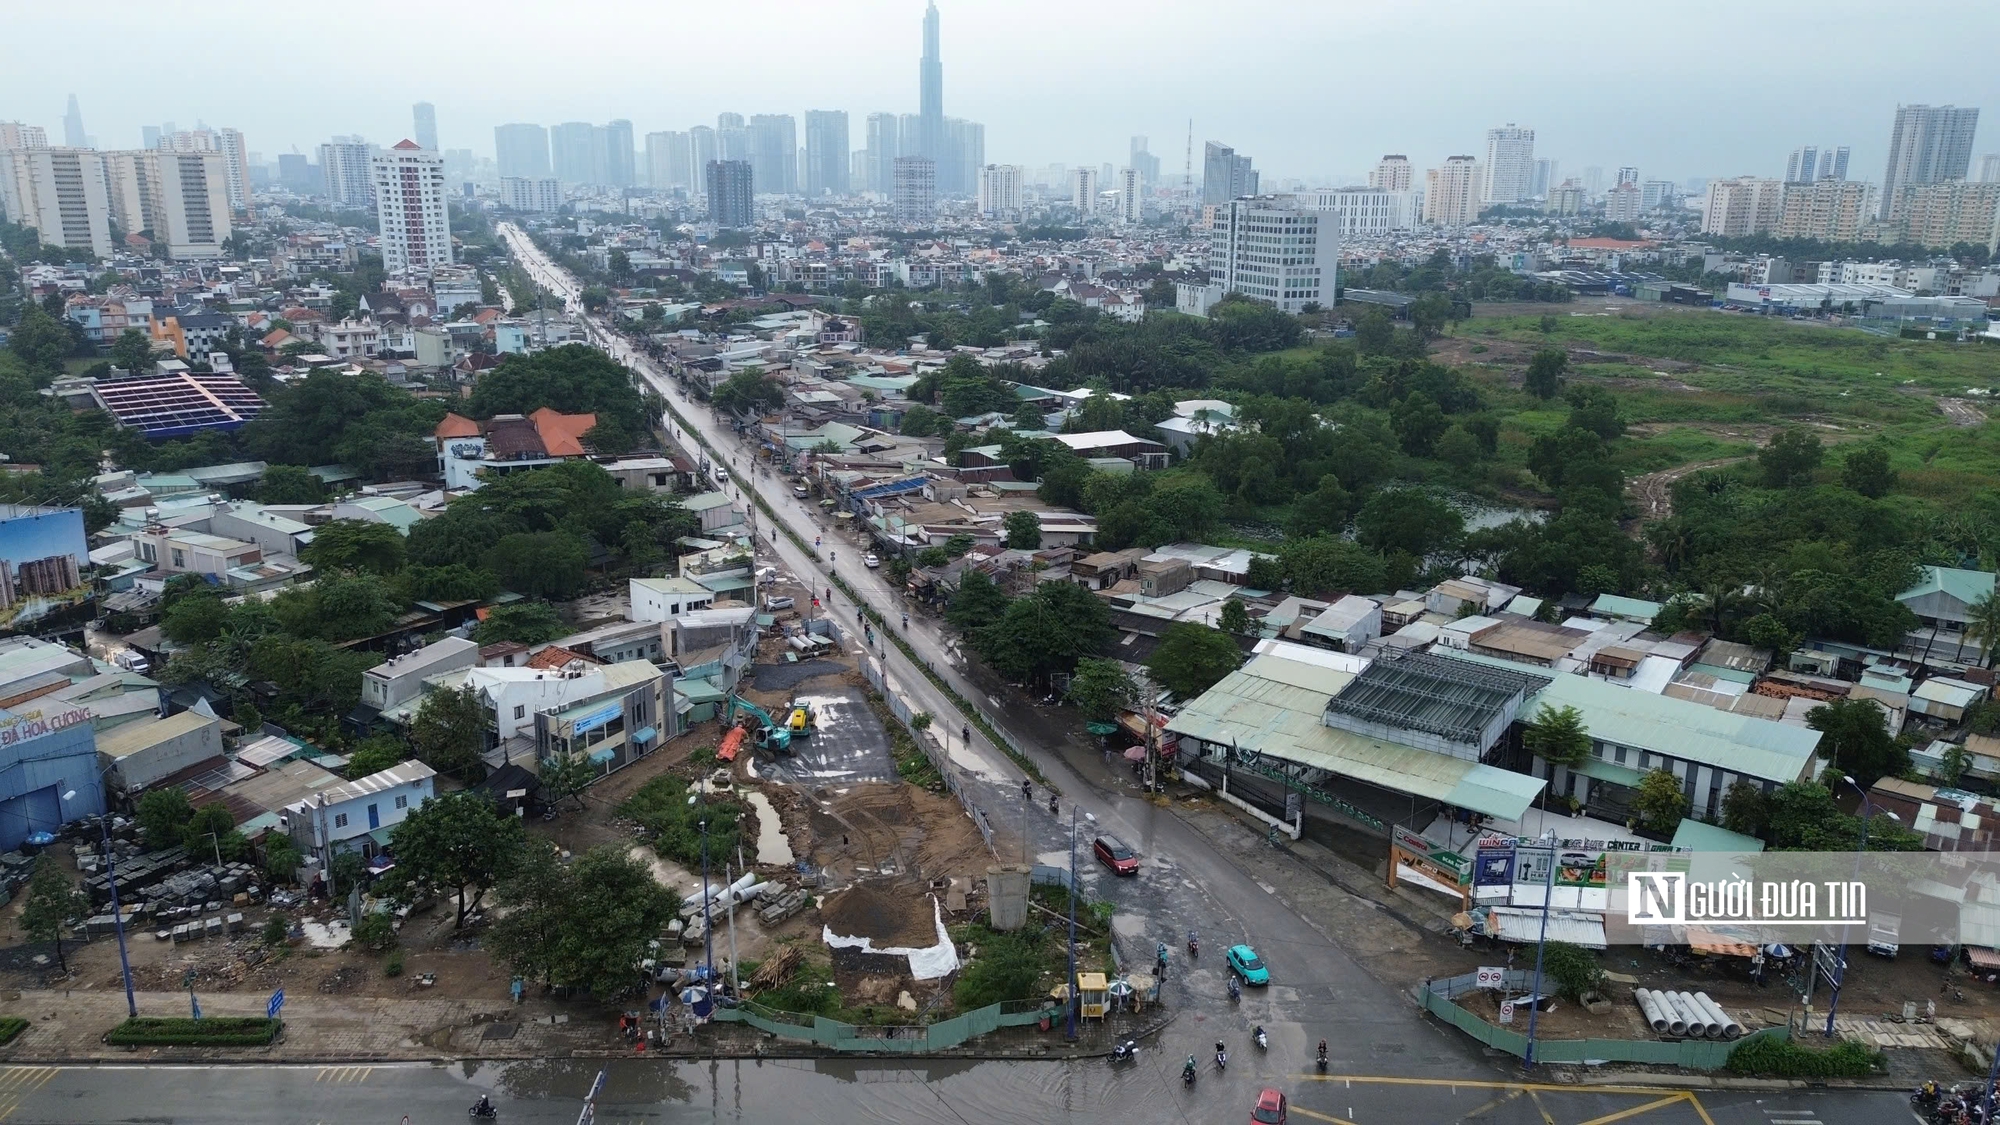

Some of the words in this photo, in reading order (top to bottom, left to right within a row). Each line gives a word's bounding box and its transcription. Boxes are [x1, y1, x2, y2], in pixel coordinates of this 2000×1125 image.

[25, 709, 43, 721] GIA
[1, 725, 20, 745] ĐÁ
[23, 720, 48, 739] HOA
[51, 707, 91, 729] CƯƠNG
[1403, 835, 1428, 852] Castrol
[1607, 840, 1641, 851] CENTER
